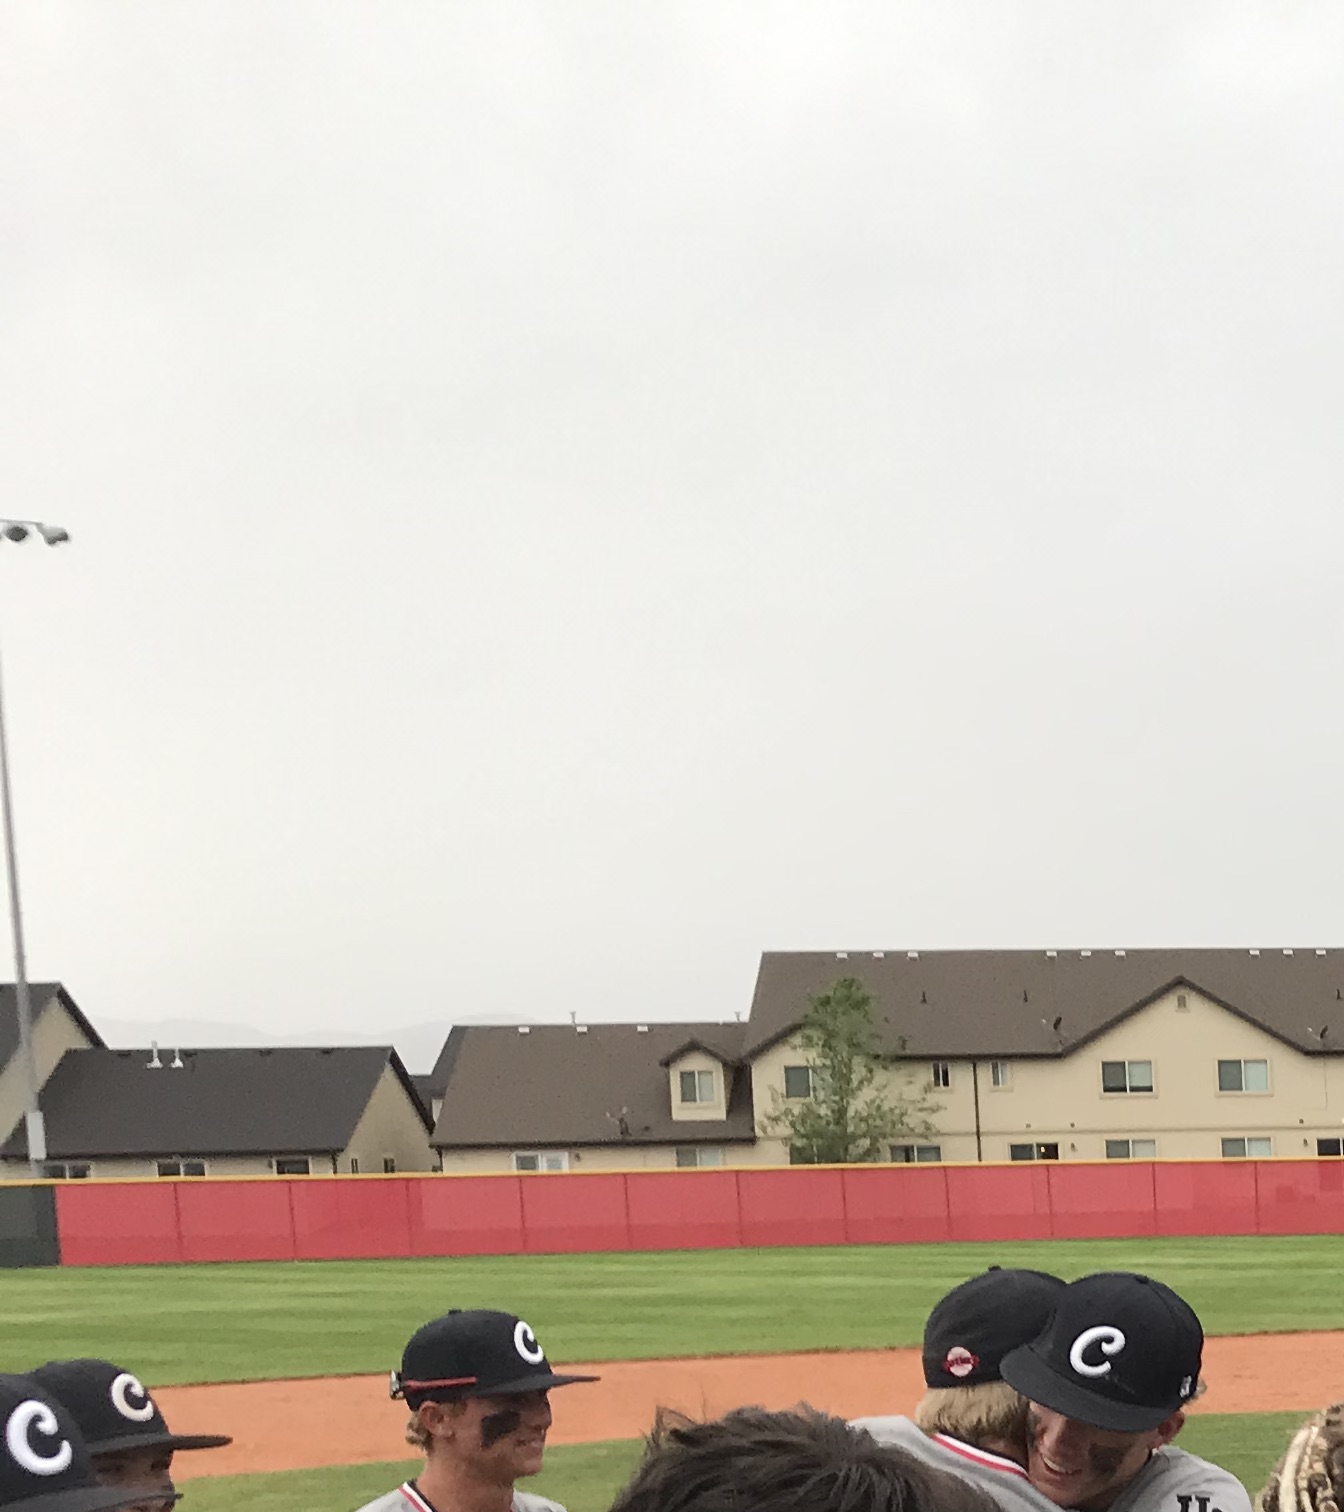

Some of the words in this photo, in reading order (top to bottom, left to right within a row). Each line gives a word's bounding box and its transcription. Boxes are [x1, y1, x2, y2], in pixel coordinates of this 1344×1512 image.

[514, 1321, 544, 1364] C
[1070, 1326, 1126, 1376] C
[110, 1373, 154, 1422] C
[6, 1399, 72, 1476] C
